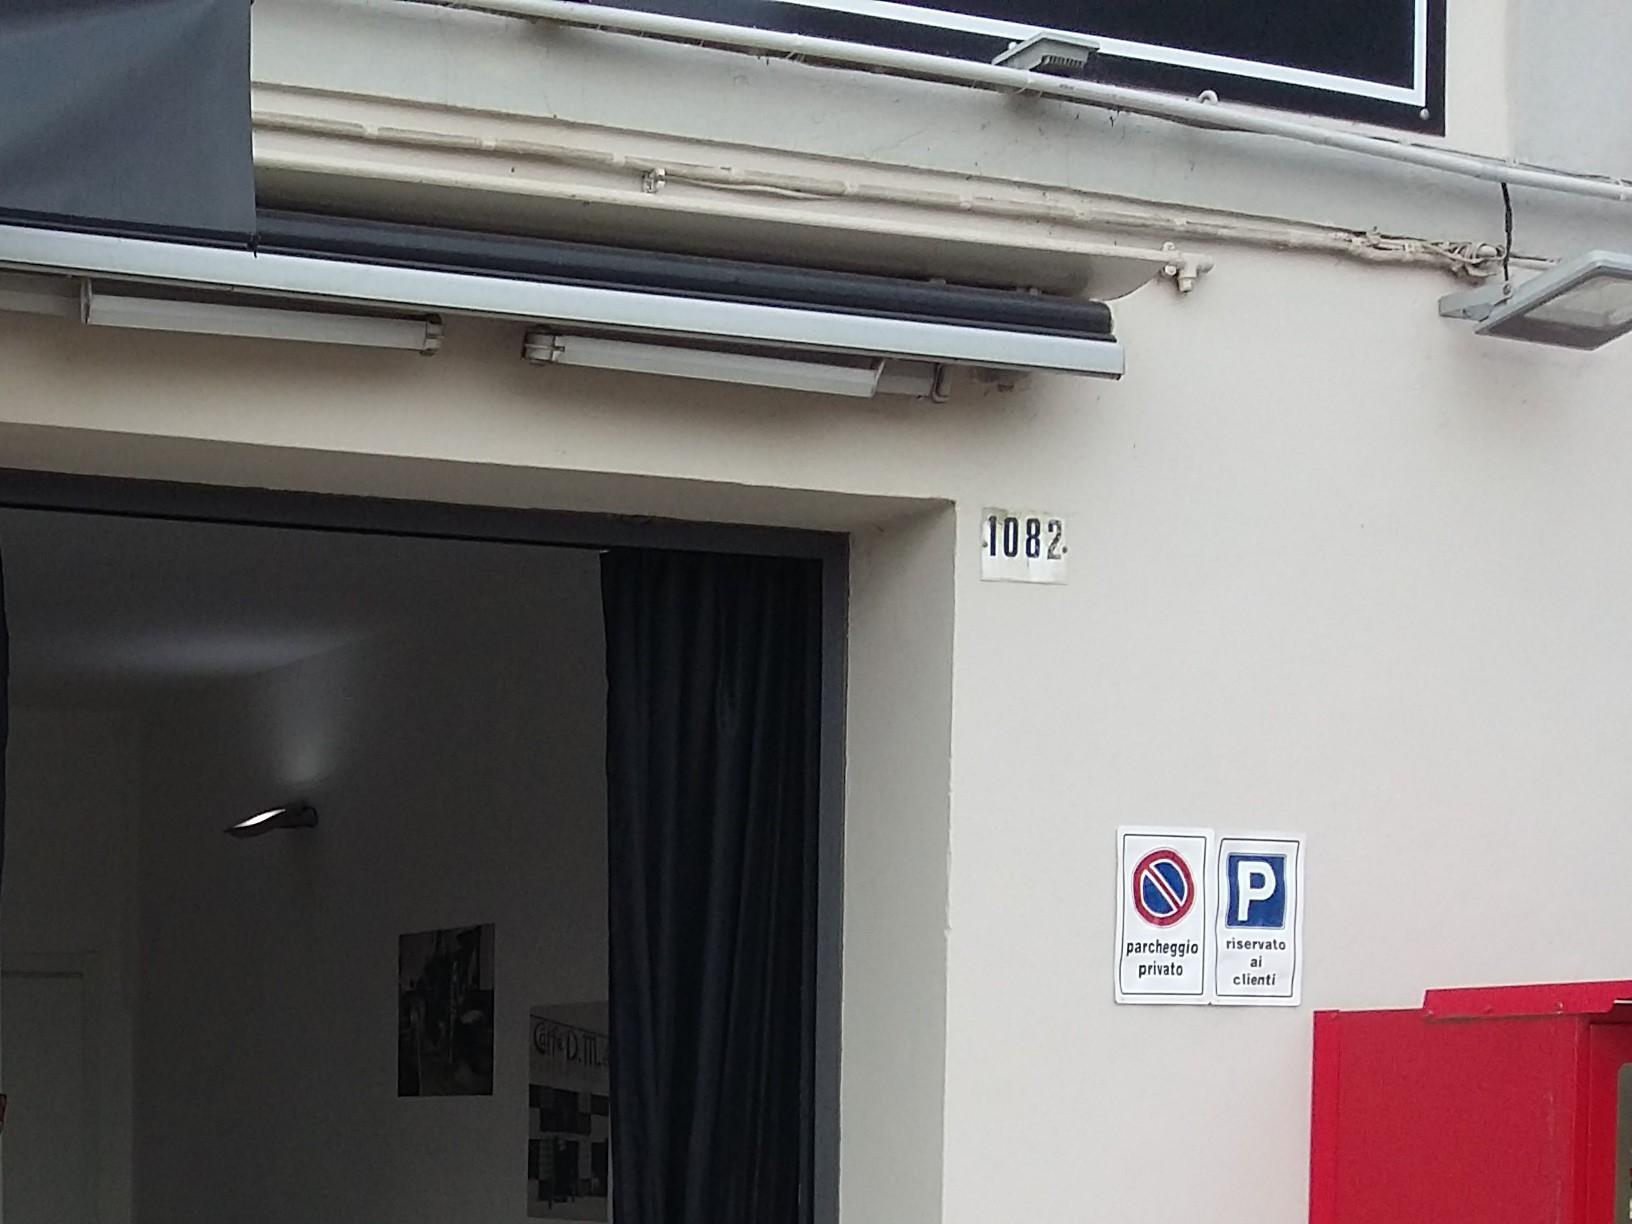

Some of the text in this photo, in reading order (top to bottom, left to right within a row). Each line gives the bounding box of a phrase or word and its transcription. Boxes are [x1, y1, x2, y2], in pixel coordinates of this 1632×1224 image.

[988, 515, 1063, 561] 1082
[1236, 859, 1278, 922] P
[1125, 938, 1199, 958] parcheggio
[1225, 936, 1287, 951] riservato
[1138, 960, 1184, 979] privato
[1249, 955, 1263, 968] ai
[1232, 972, 1277, 986] clienti
